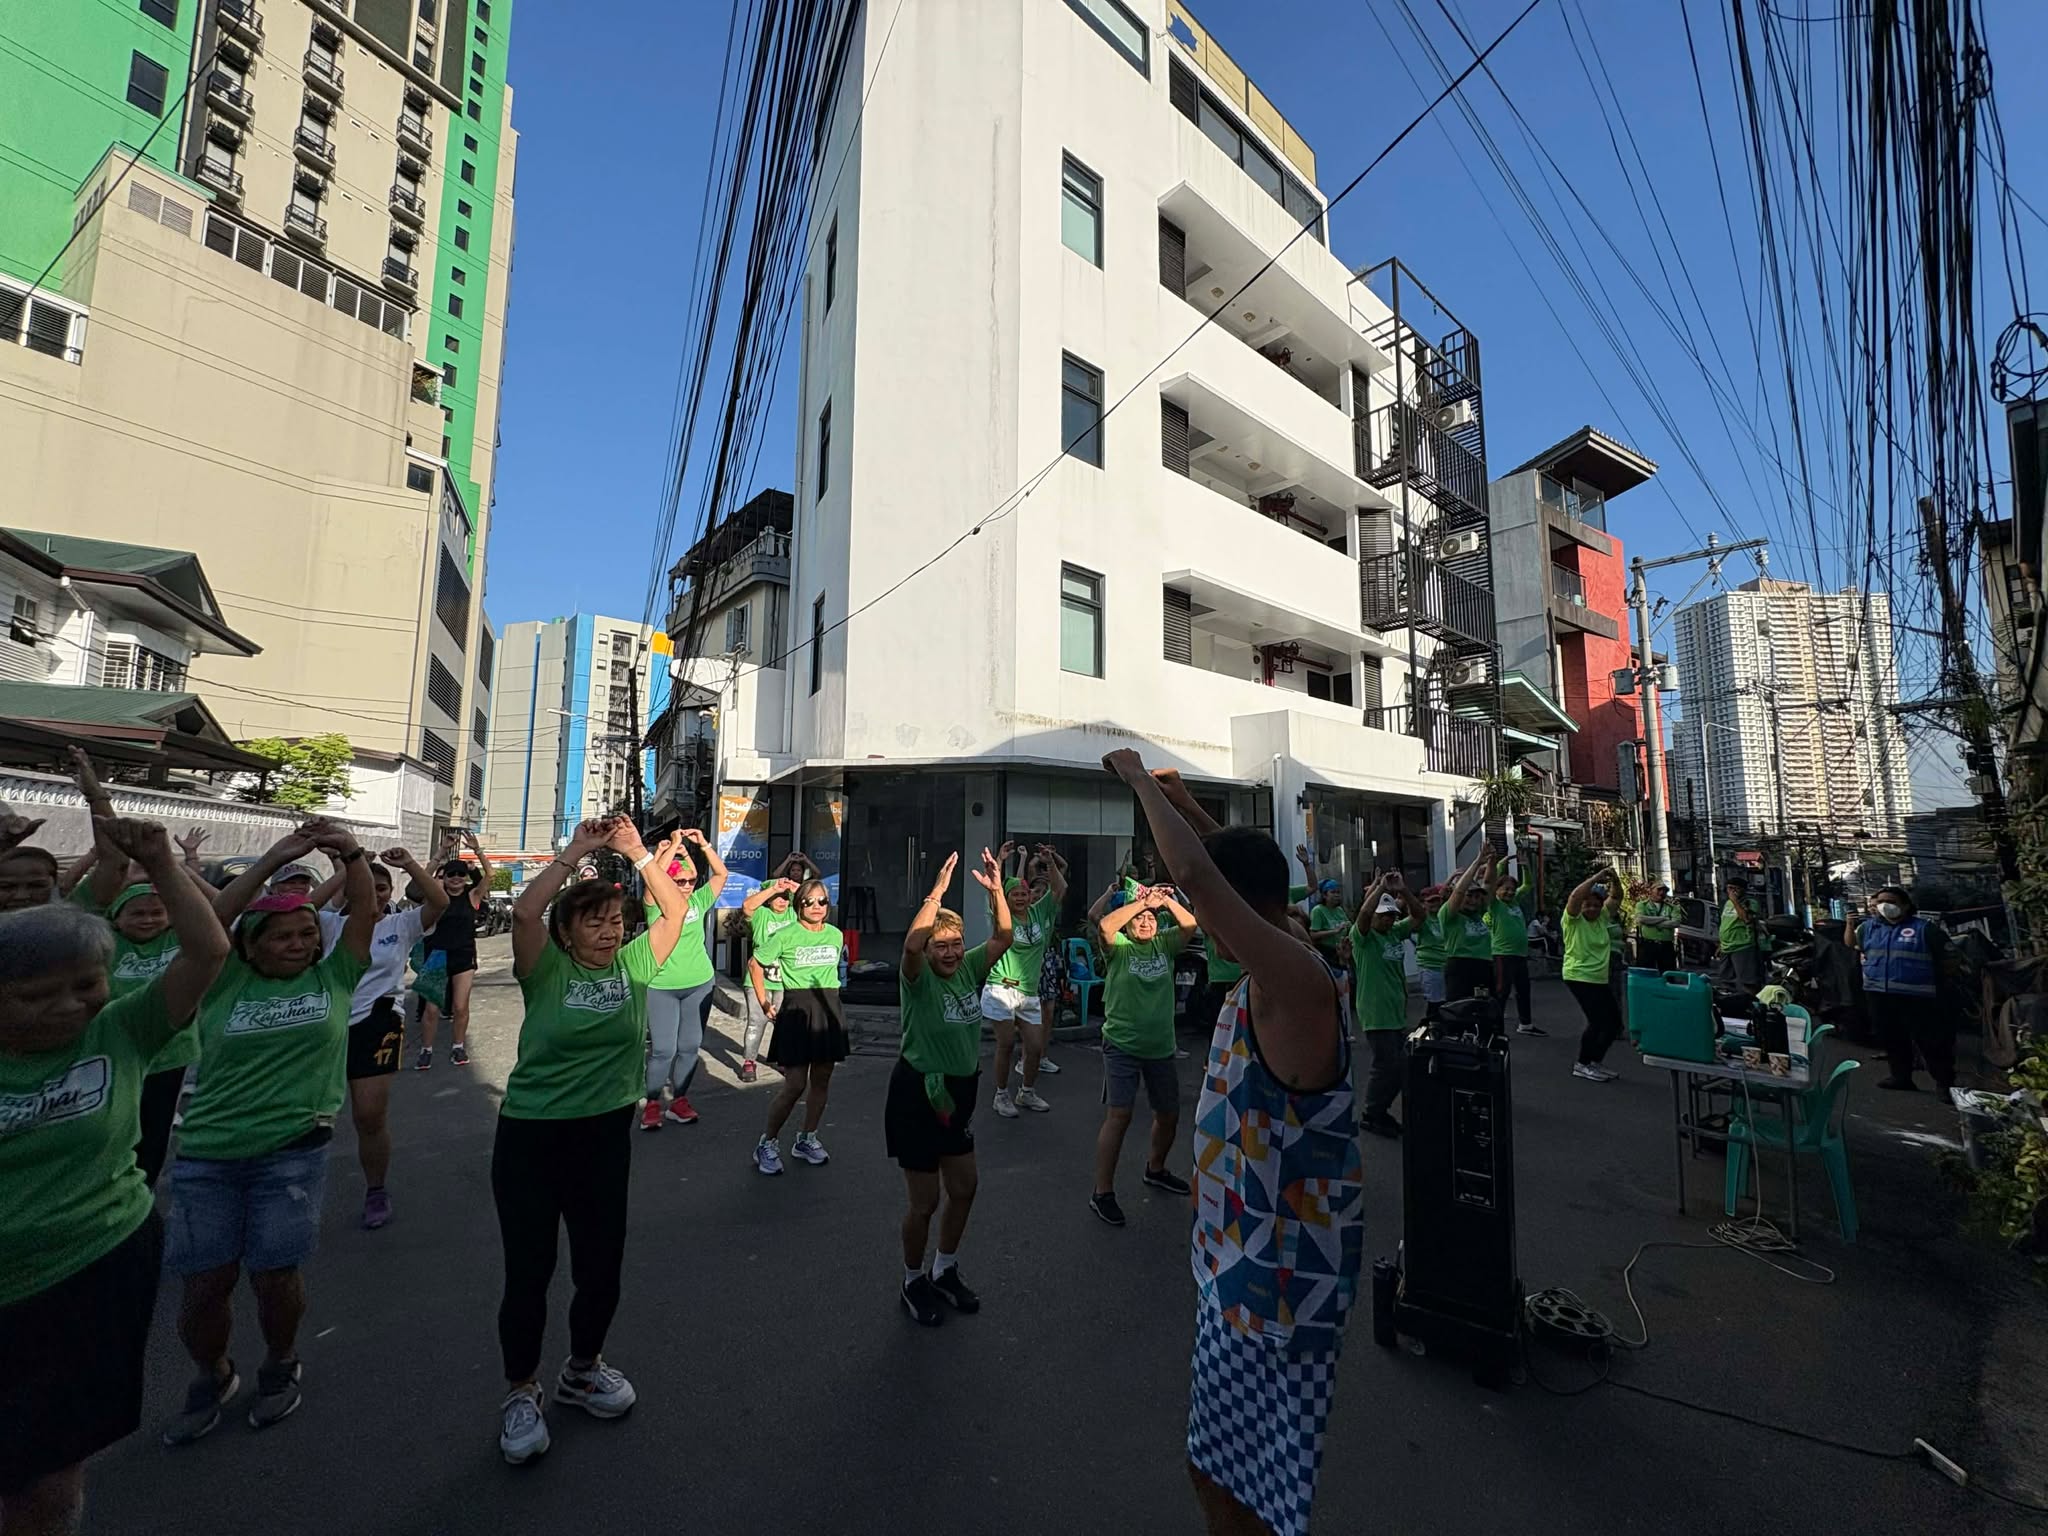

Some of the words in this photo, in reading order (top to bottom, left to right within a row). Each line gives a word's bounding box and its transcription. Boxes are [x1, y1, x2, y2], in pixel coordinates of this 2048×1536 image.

[724, 800, 763, 810] Studios
[724, 810, 740, 819] For
[723, 819, 752, 829] Rent.
[373, 1048, 393, 1066] 17
